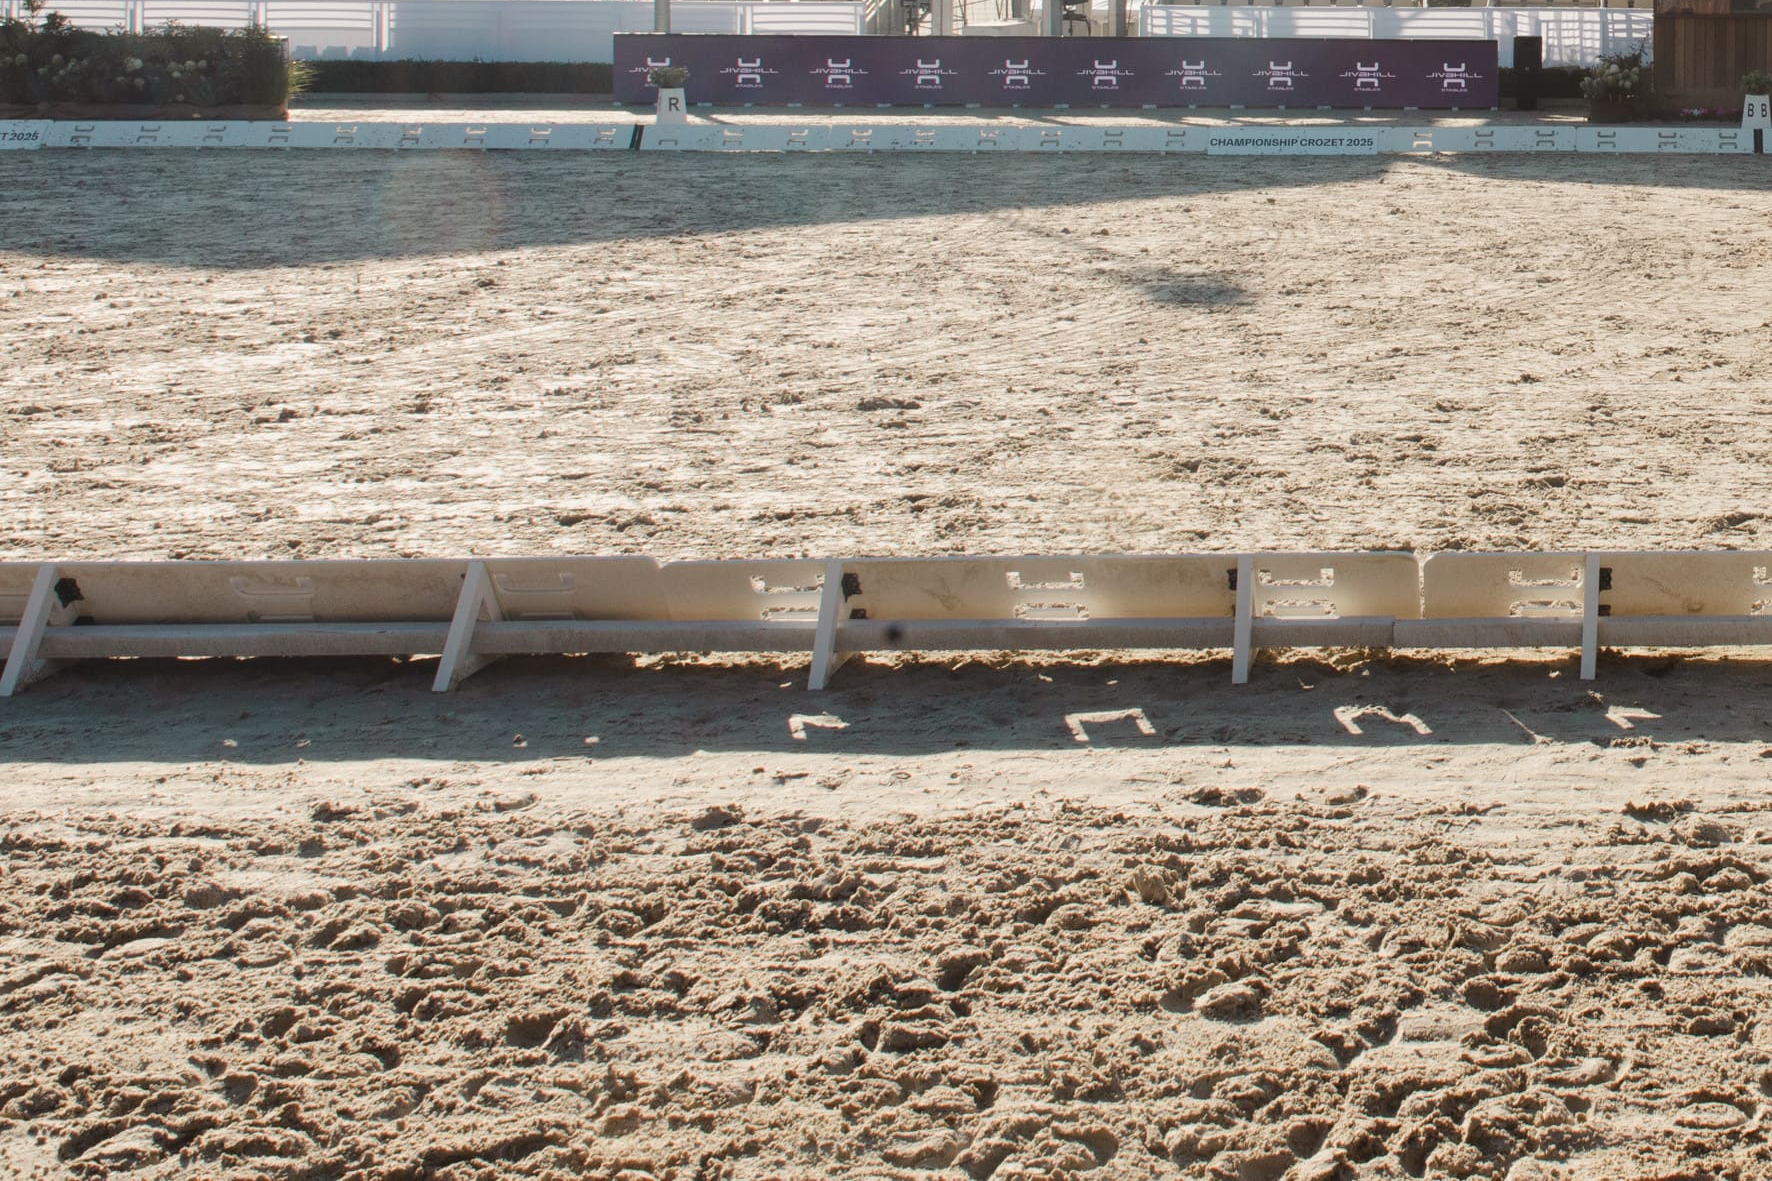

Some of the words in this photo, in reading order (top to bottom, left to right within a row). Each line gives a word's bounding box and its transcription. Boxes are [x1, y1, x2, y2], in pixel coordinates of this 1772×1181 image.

[668, 97, 680, 112] R
[1747, 103, 1755, 117] B
[1761, 103, 1767, 117] B
[9, 131, 39, 140] 2025
[1210, 138, 1298, 147] CHAMPIONSHIP
[1300, 138, 1344, 147] CROZET
[1346, 138, 1373, 147] 2025
